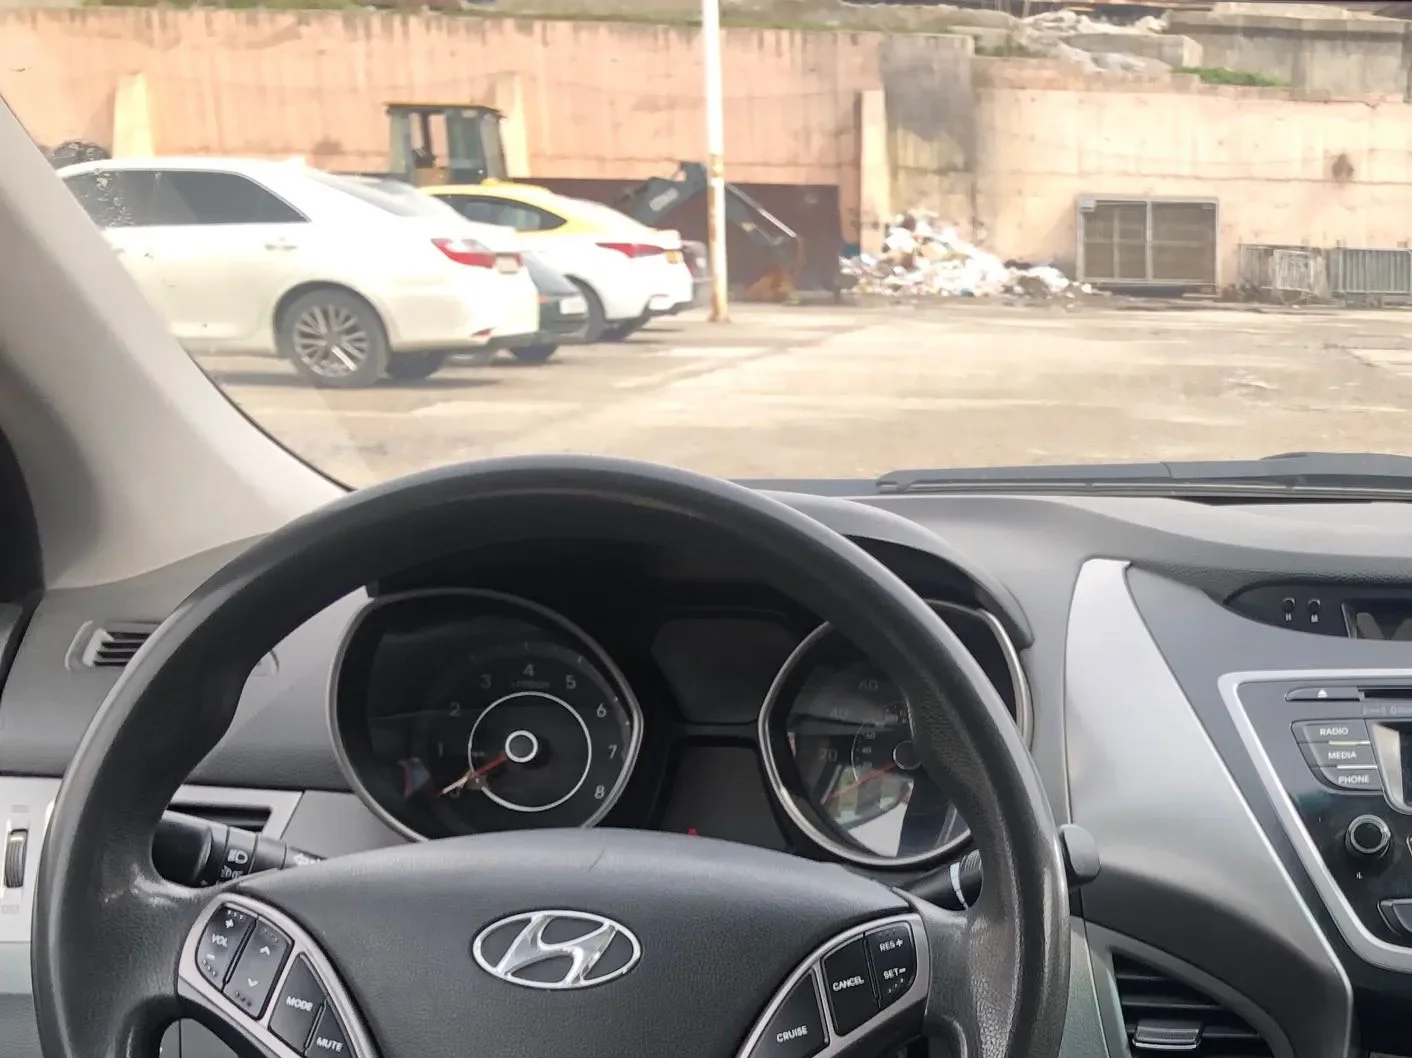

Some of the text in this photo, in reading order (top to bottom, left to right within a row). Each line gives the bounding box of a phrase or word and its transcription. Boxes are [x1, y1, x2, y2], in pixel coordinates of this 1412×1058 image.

[523, 663, 535, 677] 4
[481, 674, 492, 689] 3
[565, 674, 577, 690] 5
[449, 702, 461, 717] 2
[596, 703, 607, 718] 6
[1319, 726, 1349, 736] RADIO
[608, 744, 618, 760] 7
[1327, 750, 1358, 760] MEDIA
[1338, 774, 1370, 784] PHONE
[594, 784, 605, 800] 8
[211, 934, 228, 948] VOL
[832, 975, 865, 992] CANCEL
[285, 996, 313, 1012] MODE
[776, 1025, 809, 1043] CRUISE
[316, 1036, 343, 1052] MUTE
